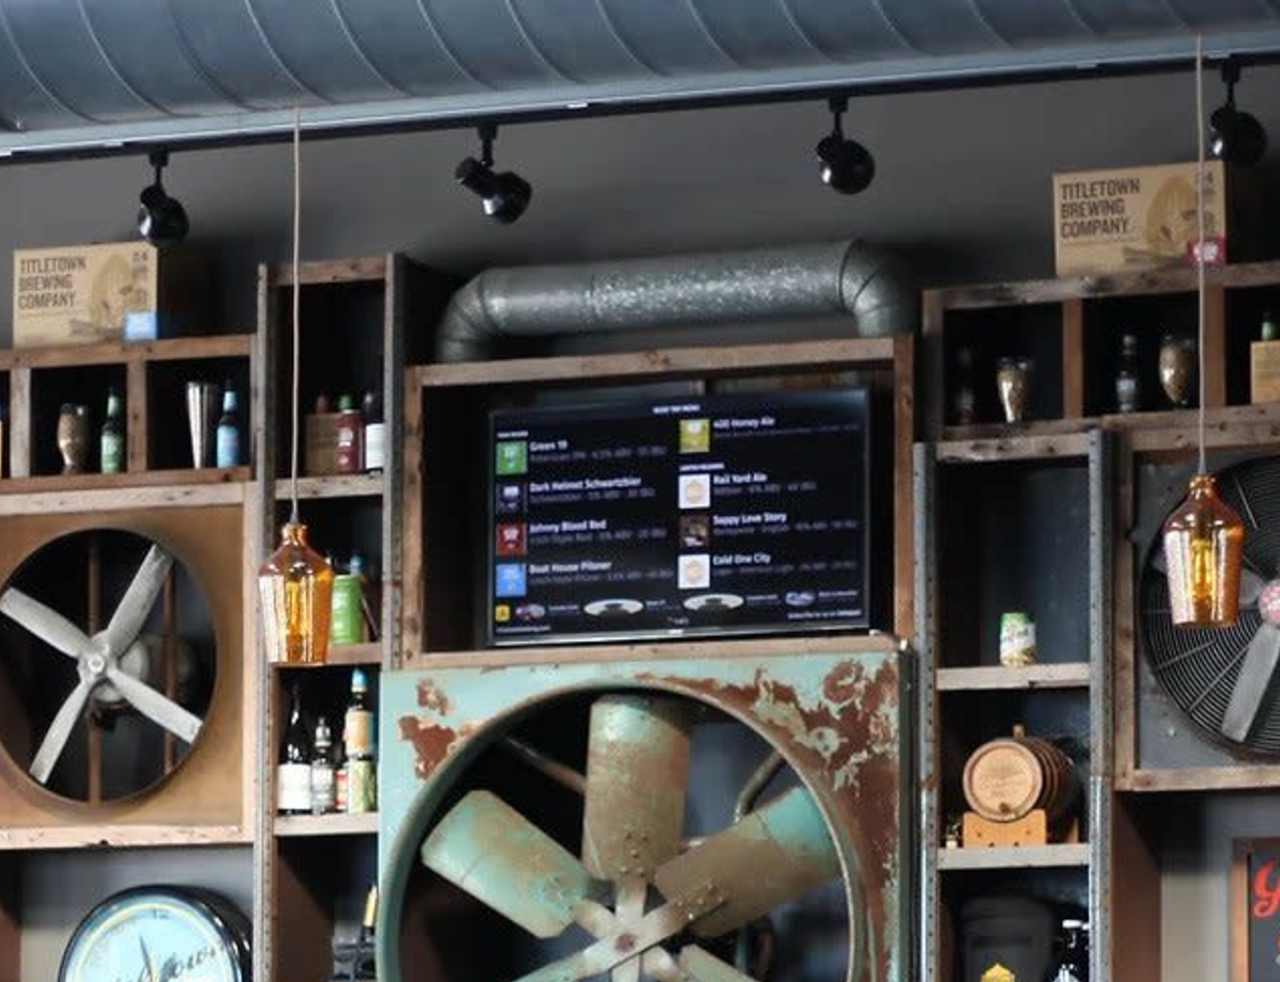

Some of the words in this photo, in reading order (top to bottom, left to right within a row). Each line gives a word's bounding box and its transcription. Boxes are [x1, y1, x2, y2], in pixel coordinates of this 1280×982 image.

[1060, 178, 1141, 200] TITLETOWN
[1061, 197, 1126, 219] BREWING
[1061, 216, 1129, 239] COMPANY
[20, 255, 87, 273] TITLETOWN
[19, 273, 73, 292] BREWING
[19, 291, 76, 310] COMPANY
